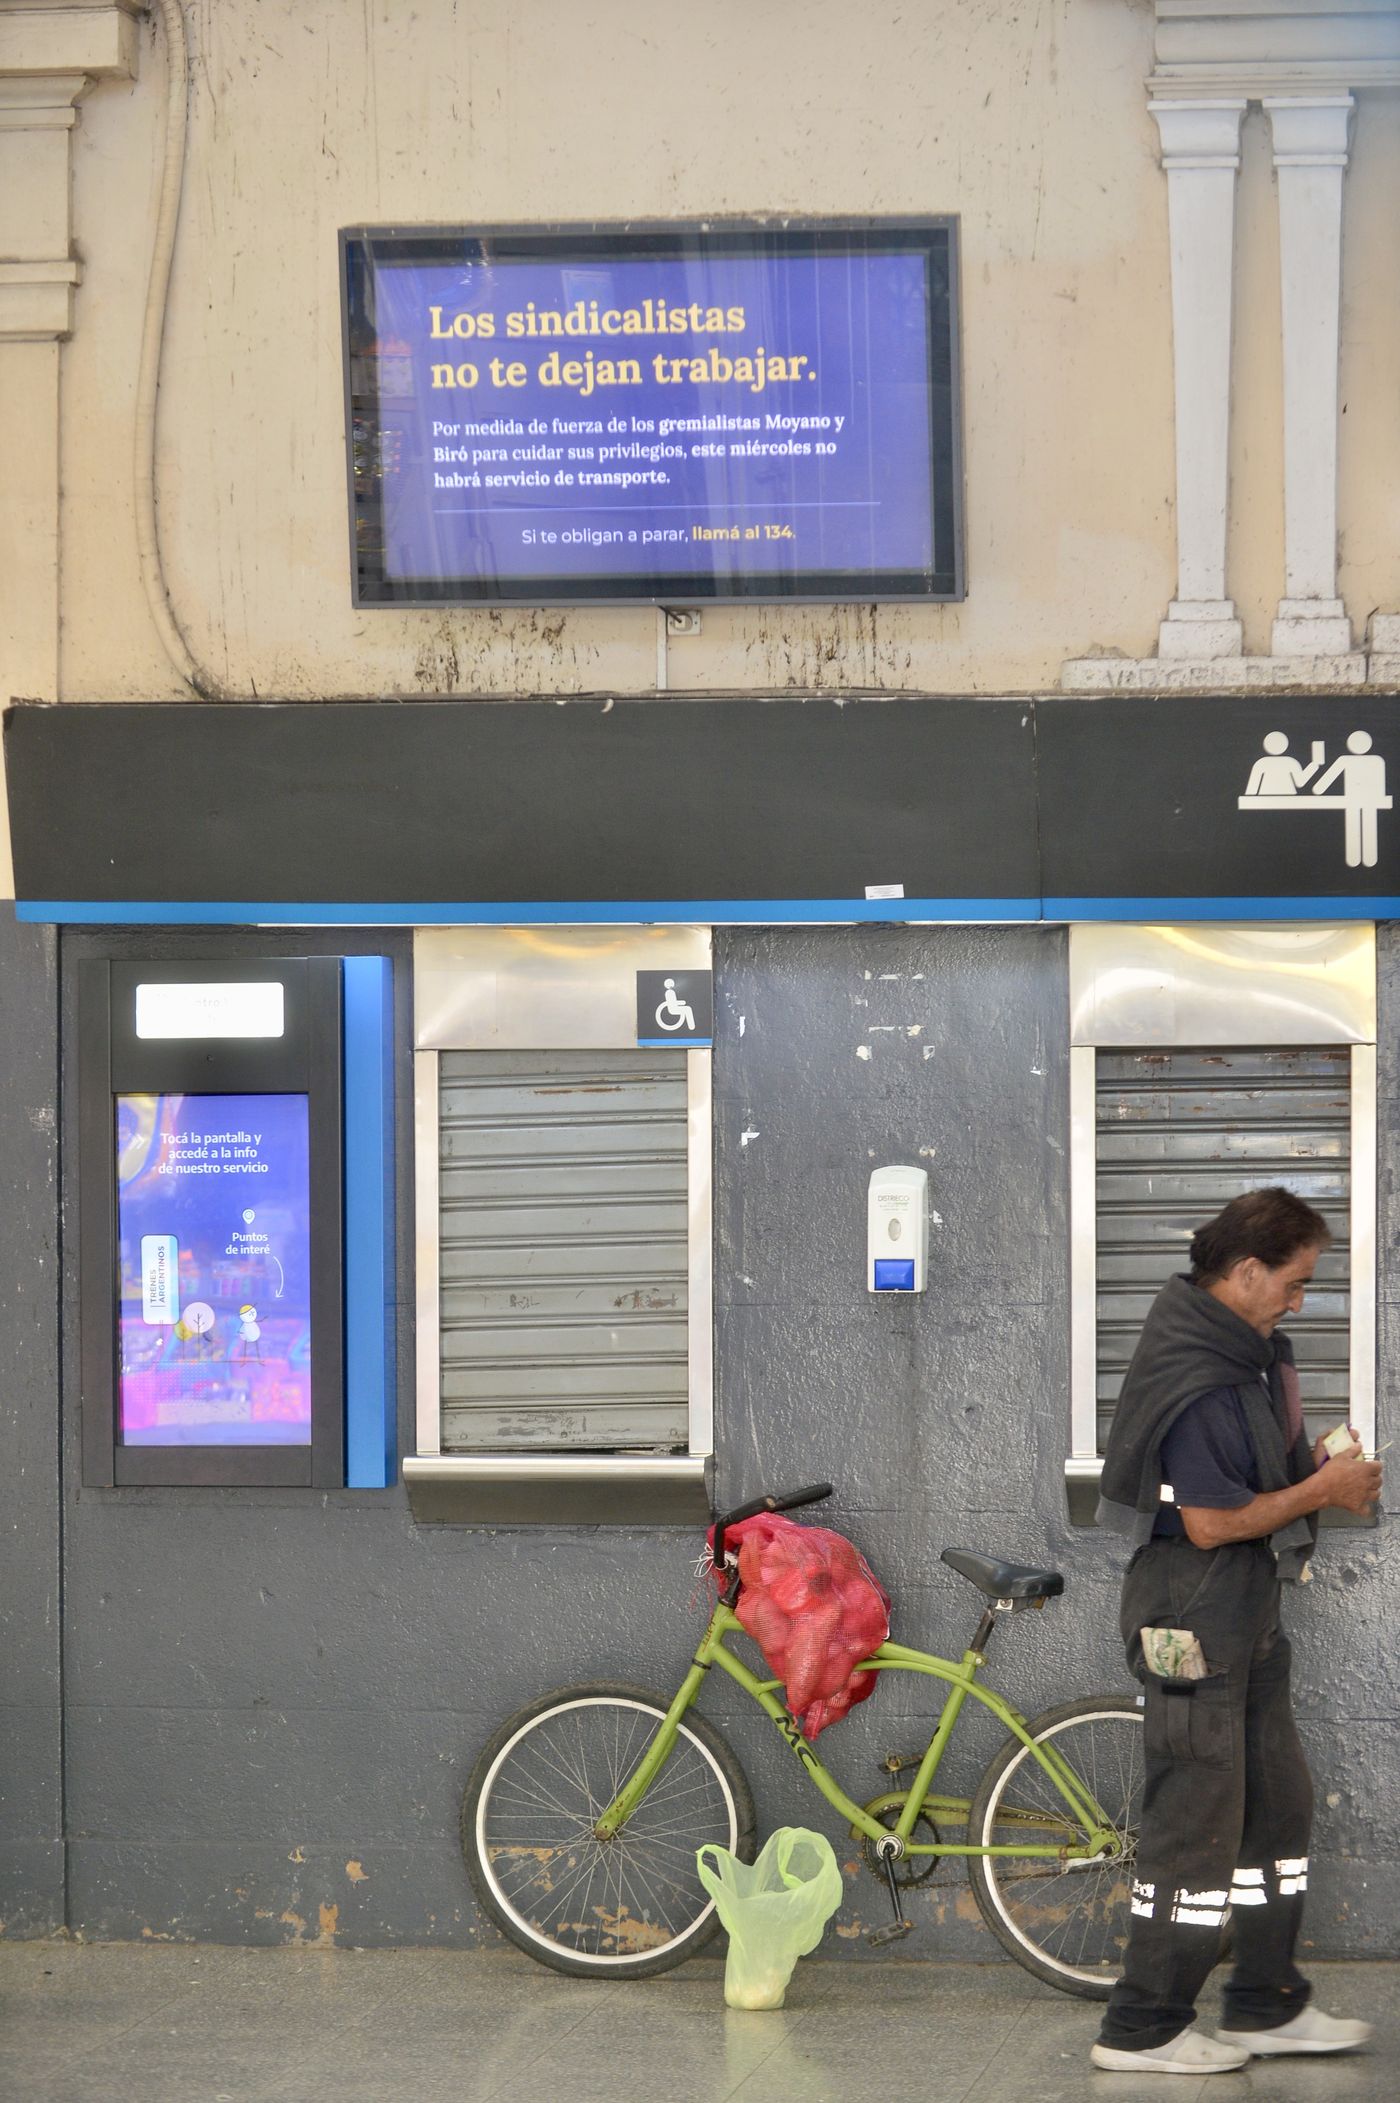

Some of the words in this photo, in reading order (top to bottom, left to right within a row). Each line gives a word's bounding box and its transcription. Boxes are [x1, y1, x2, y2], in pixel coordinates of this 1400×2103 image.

[428, 305, 496, 338] Los
[505, 299, 746, 337] sindicalistas
[430, 362, 479, 389] no
[489, 357, 528, 388] te
[538, 350, 643, 396] dejan
[652, 346, 817, 393] trabajar.
[432, 420, 461, 437] Por
[464, 418, 524, 436] medida
[528, 418, 548, 434] de
[552, 417, 603, 434] fuerza
[607, 416, 627, 433] de
[631, 416, 655, 432] los
[658, 414, 761, 437] gremialistas
[765, 413, 831, 434] Moyano
[834, 415, 845, 433] y
[433, 446, 468, 463] Biró
[472, 450, 508, 467] para
[512, 445, 564, 462] cuidar
[567, 446, 595, 460] sus
[599, 441, 688, 465] privilegios,
[691, 442, 726, 458] este
[730, 439, 812, 457] miércoles
[815, 441, 837, 455] no
[434, 471, 482, 489] habrá
[485, 470, 551, 488] servicio
[554, 470, 574, 486] de
[578, 469, 671, 489] transporte.
[521, 528, 537, 544] Si
[540, 530, 557, 544] te
[561, 527, 624, 546] obligan
[628, 530, 637, 542] a
[642, 528, 689, 545] parar,
[692, 525, 740, 540] llamá
[745, 524, 760, 539] al
[764, 524, 797, 539] 134.
[160, 1132, 188, 1144] Tocá
[191, 1132, 201, 1144] la
[204, 1131, 251, 1146] pantalla
[254, 1134, 262, 1146] y
[168, 1146, 208, 1159] accedé
[211, 1149, 218, 1159] a
[221, 1146, 231, 1158] la
[234, 1146, 258, 1158] info
[158, 1162, 173, 1174] de
[175, 1162, 221, 1174] nuestro
[223, 1162, 269, 1173] servicio
[232, 1232, 268, 1242] Puntos
[225, 1244, 239, 1255] de
[158, 1245, 166, 1303] ARGENTINOS
[149, 1269, 157, 1303] TRENES
